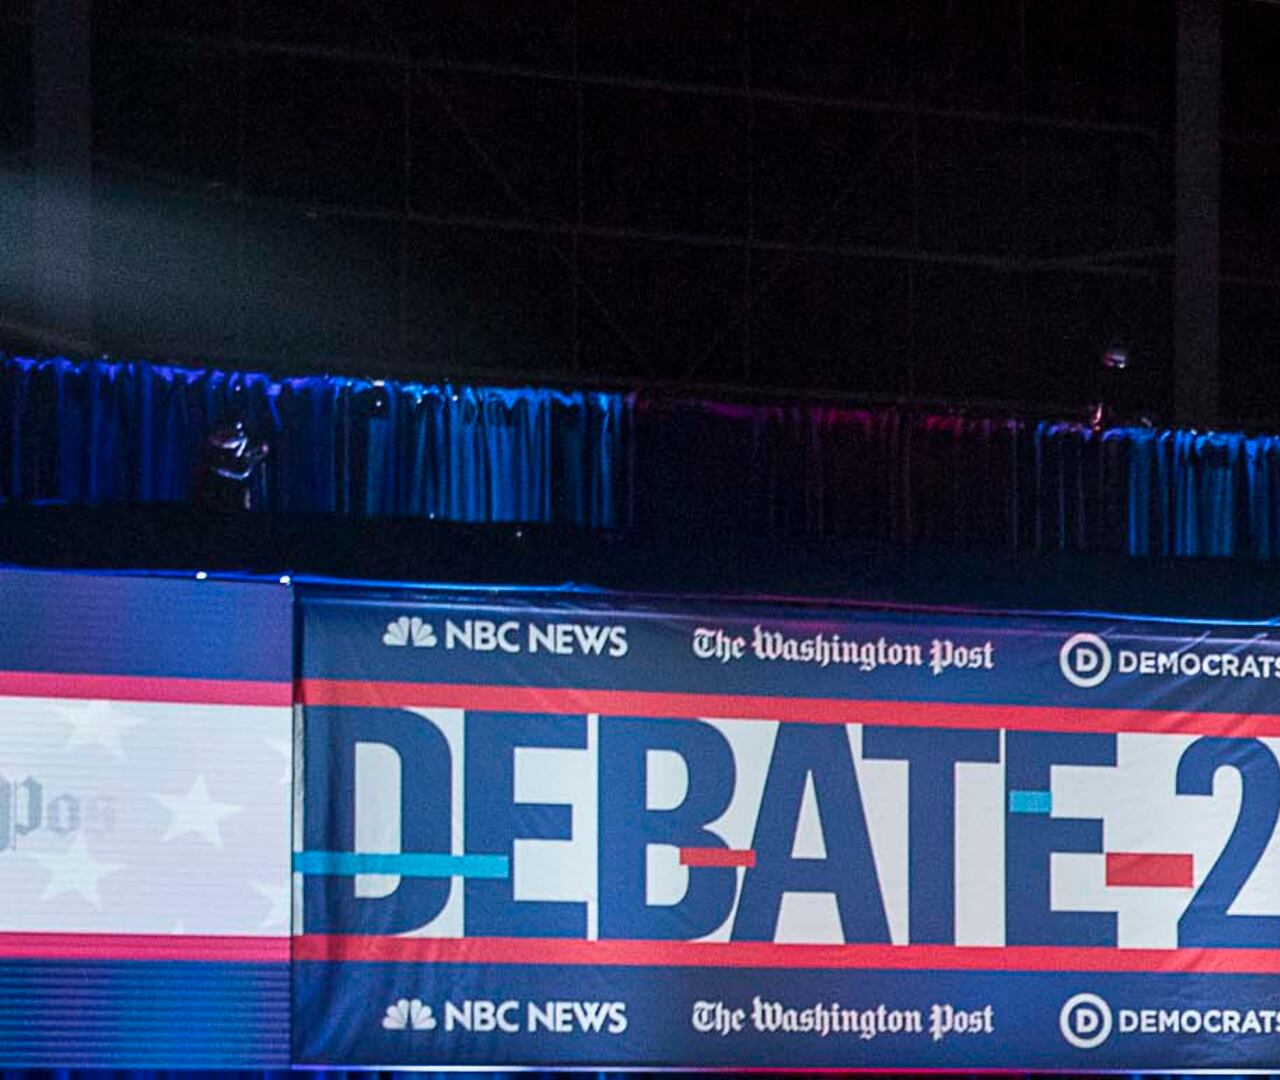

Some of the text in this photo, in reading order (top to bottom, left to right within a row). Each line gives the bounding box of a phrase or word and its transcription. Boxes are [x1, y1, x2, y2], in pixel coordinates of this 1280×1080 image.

[445, 619, 628, 657] NBC NEWS
[692, 624, 995, 676] The Washington Post
[302, 705, 1119, 948] DEBATE
[444, 1000, 628, 1034] NBC NEWS
[692, 995, 995, 1042] The Washington Post
